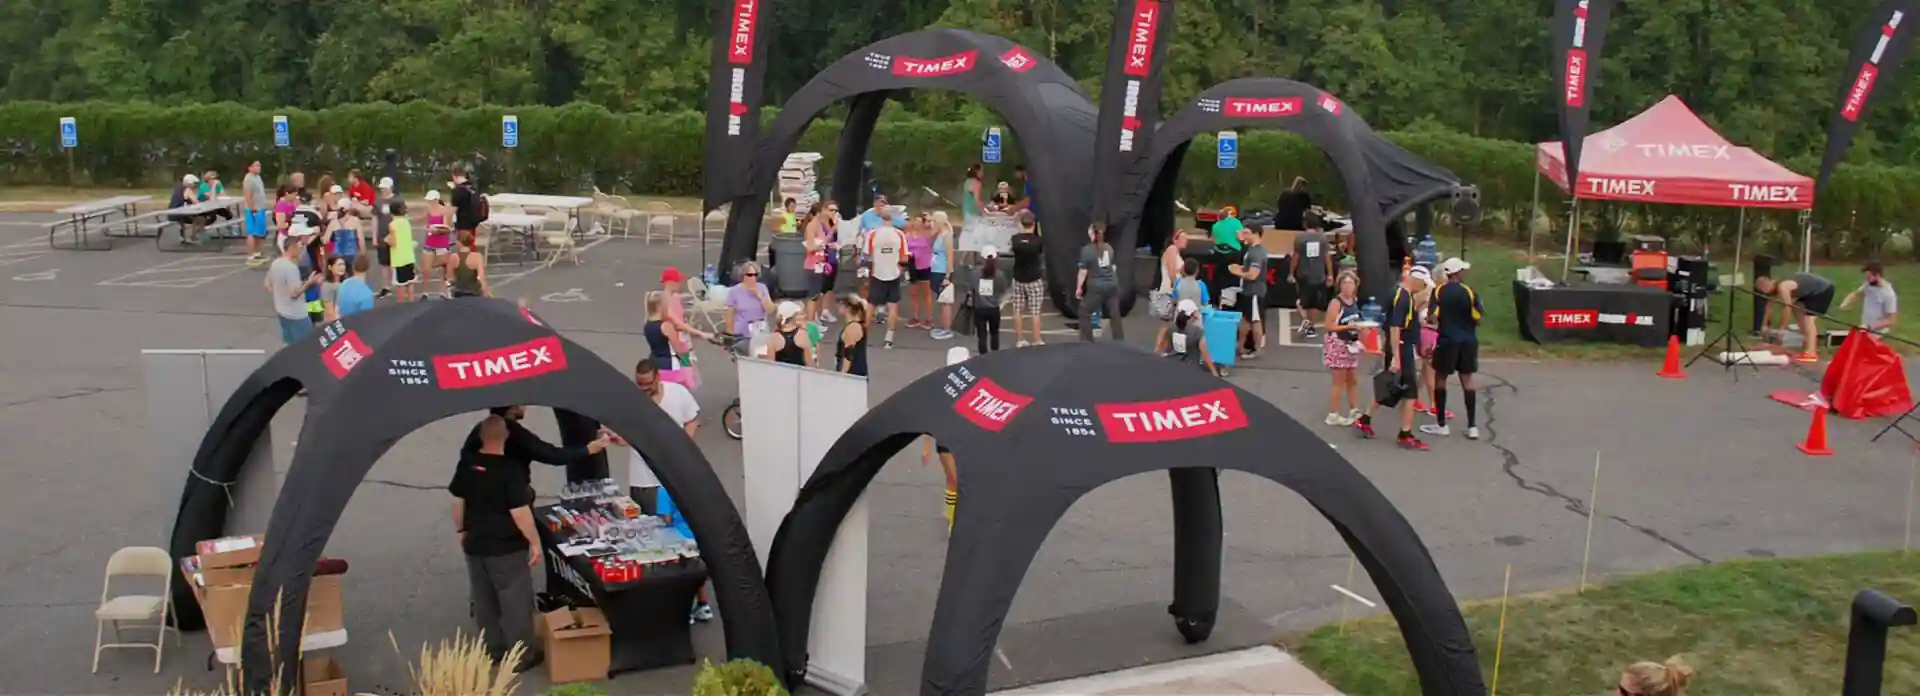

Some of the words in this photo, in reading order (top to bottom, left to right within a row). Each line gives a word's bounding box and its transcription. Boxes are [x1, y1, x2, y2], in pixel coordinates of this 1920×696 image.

[734, 0, 753, 56] TIMEX
[1131, 8, 1153, 68] TIMEX
[903, 57, 968, 73] TIMEX
[1567, 56, 1582, 100] TIMEX
[1847, 70, 1872, 111] TIMEX
[1232, 102, 1293, 113] TIMEX
[1635, 143, 1731, 160] TIMEX
[1587, 178, 1657, 195] TIMEX
[1728, 184, 1798, 201] TIMEX
[1549, 313, 1591, 324] TIMEX
[390, 359, 425, 367] TRUE
[448, 346, 552, 380] TIMEX
[388, 368, 428, 376] SINCE
[969, 388, 1019, 421] TIMEX
[1051, 407, 1088, 416] TRUE
[1050, 417, 1093, 426] SINCE
[1112, 400, 1229, 432] TIMEX
